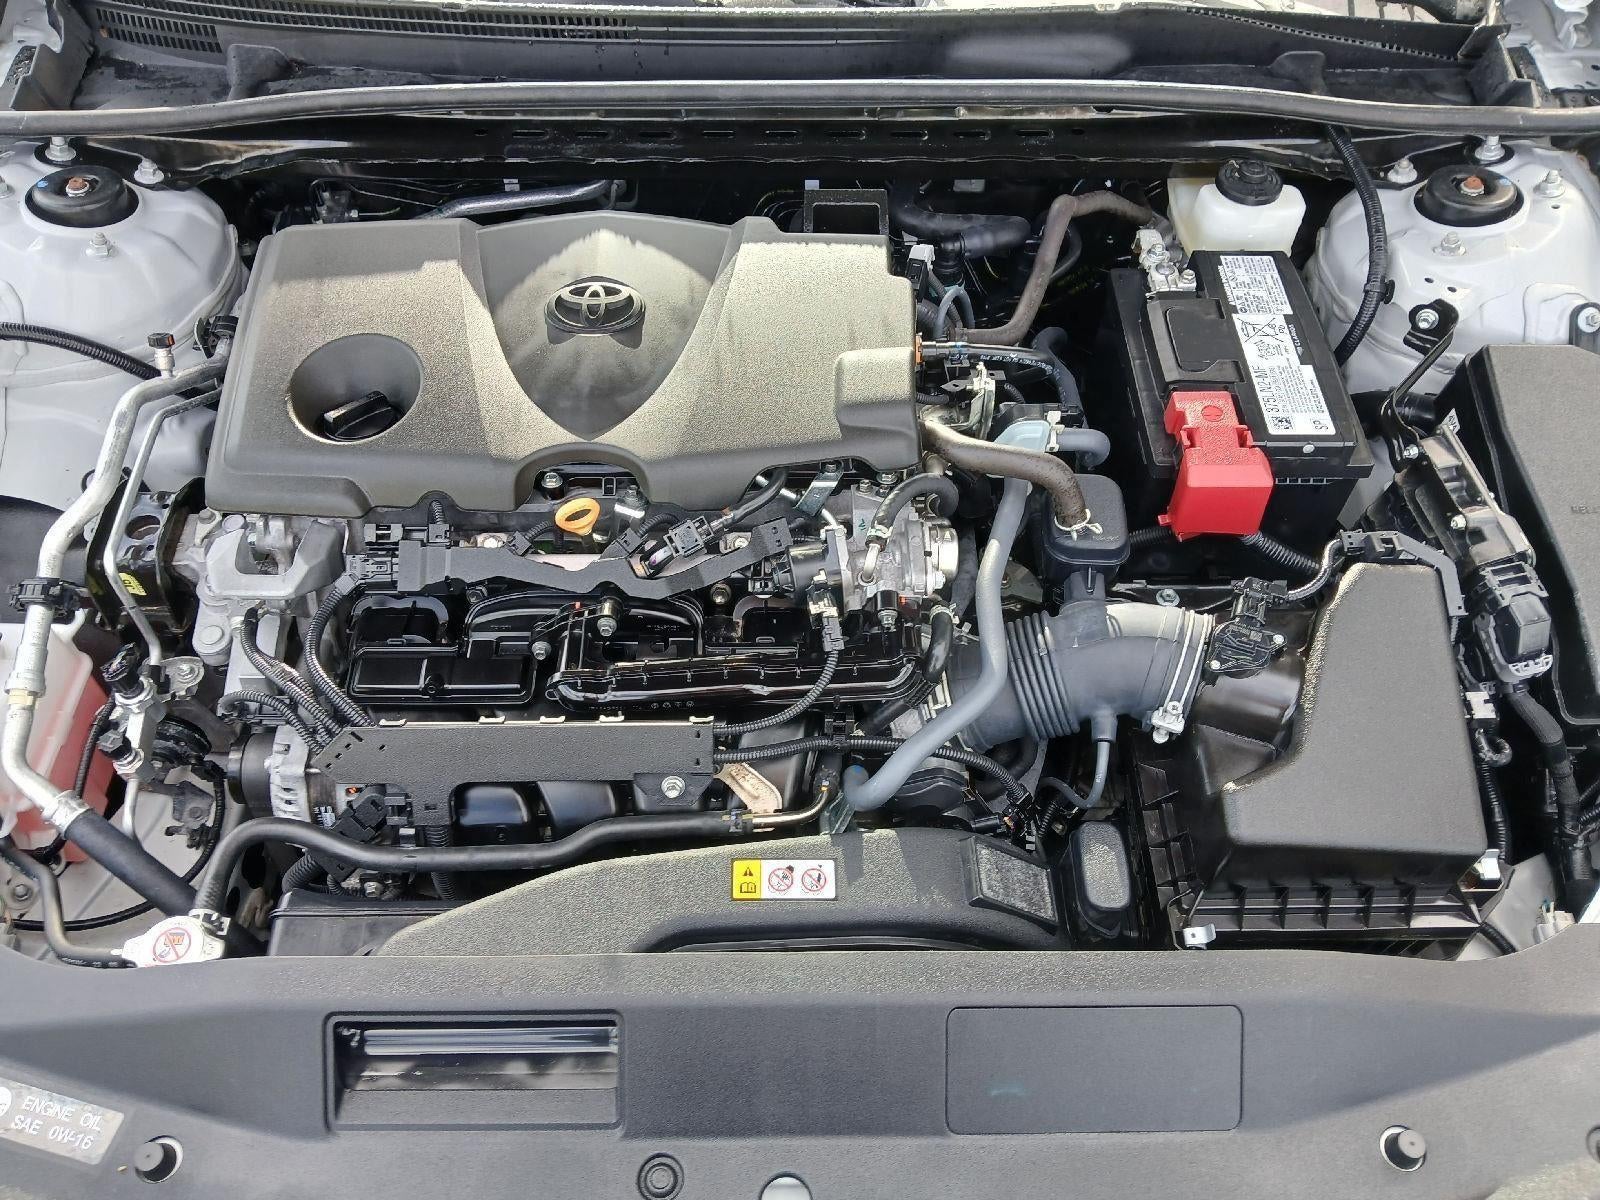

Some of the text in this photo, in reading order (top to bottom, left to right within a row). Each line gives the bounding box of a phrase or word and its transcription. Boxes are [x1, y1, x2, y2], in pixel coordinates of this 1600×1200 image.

[23, 1095, 103, 1131] ENGINE OIL
[14, 1114, 95, 1150] SAE 0W-16
